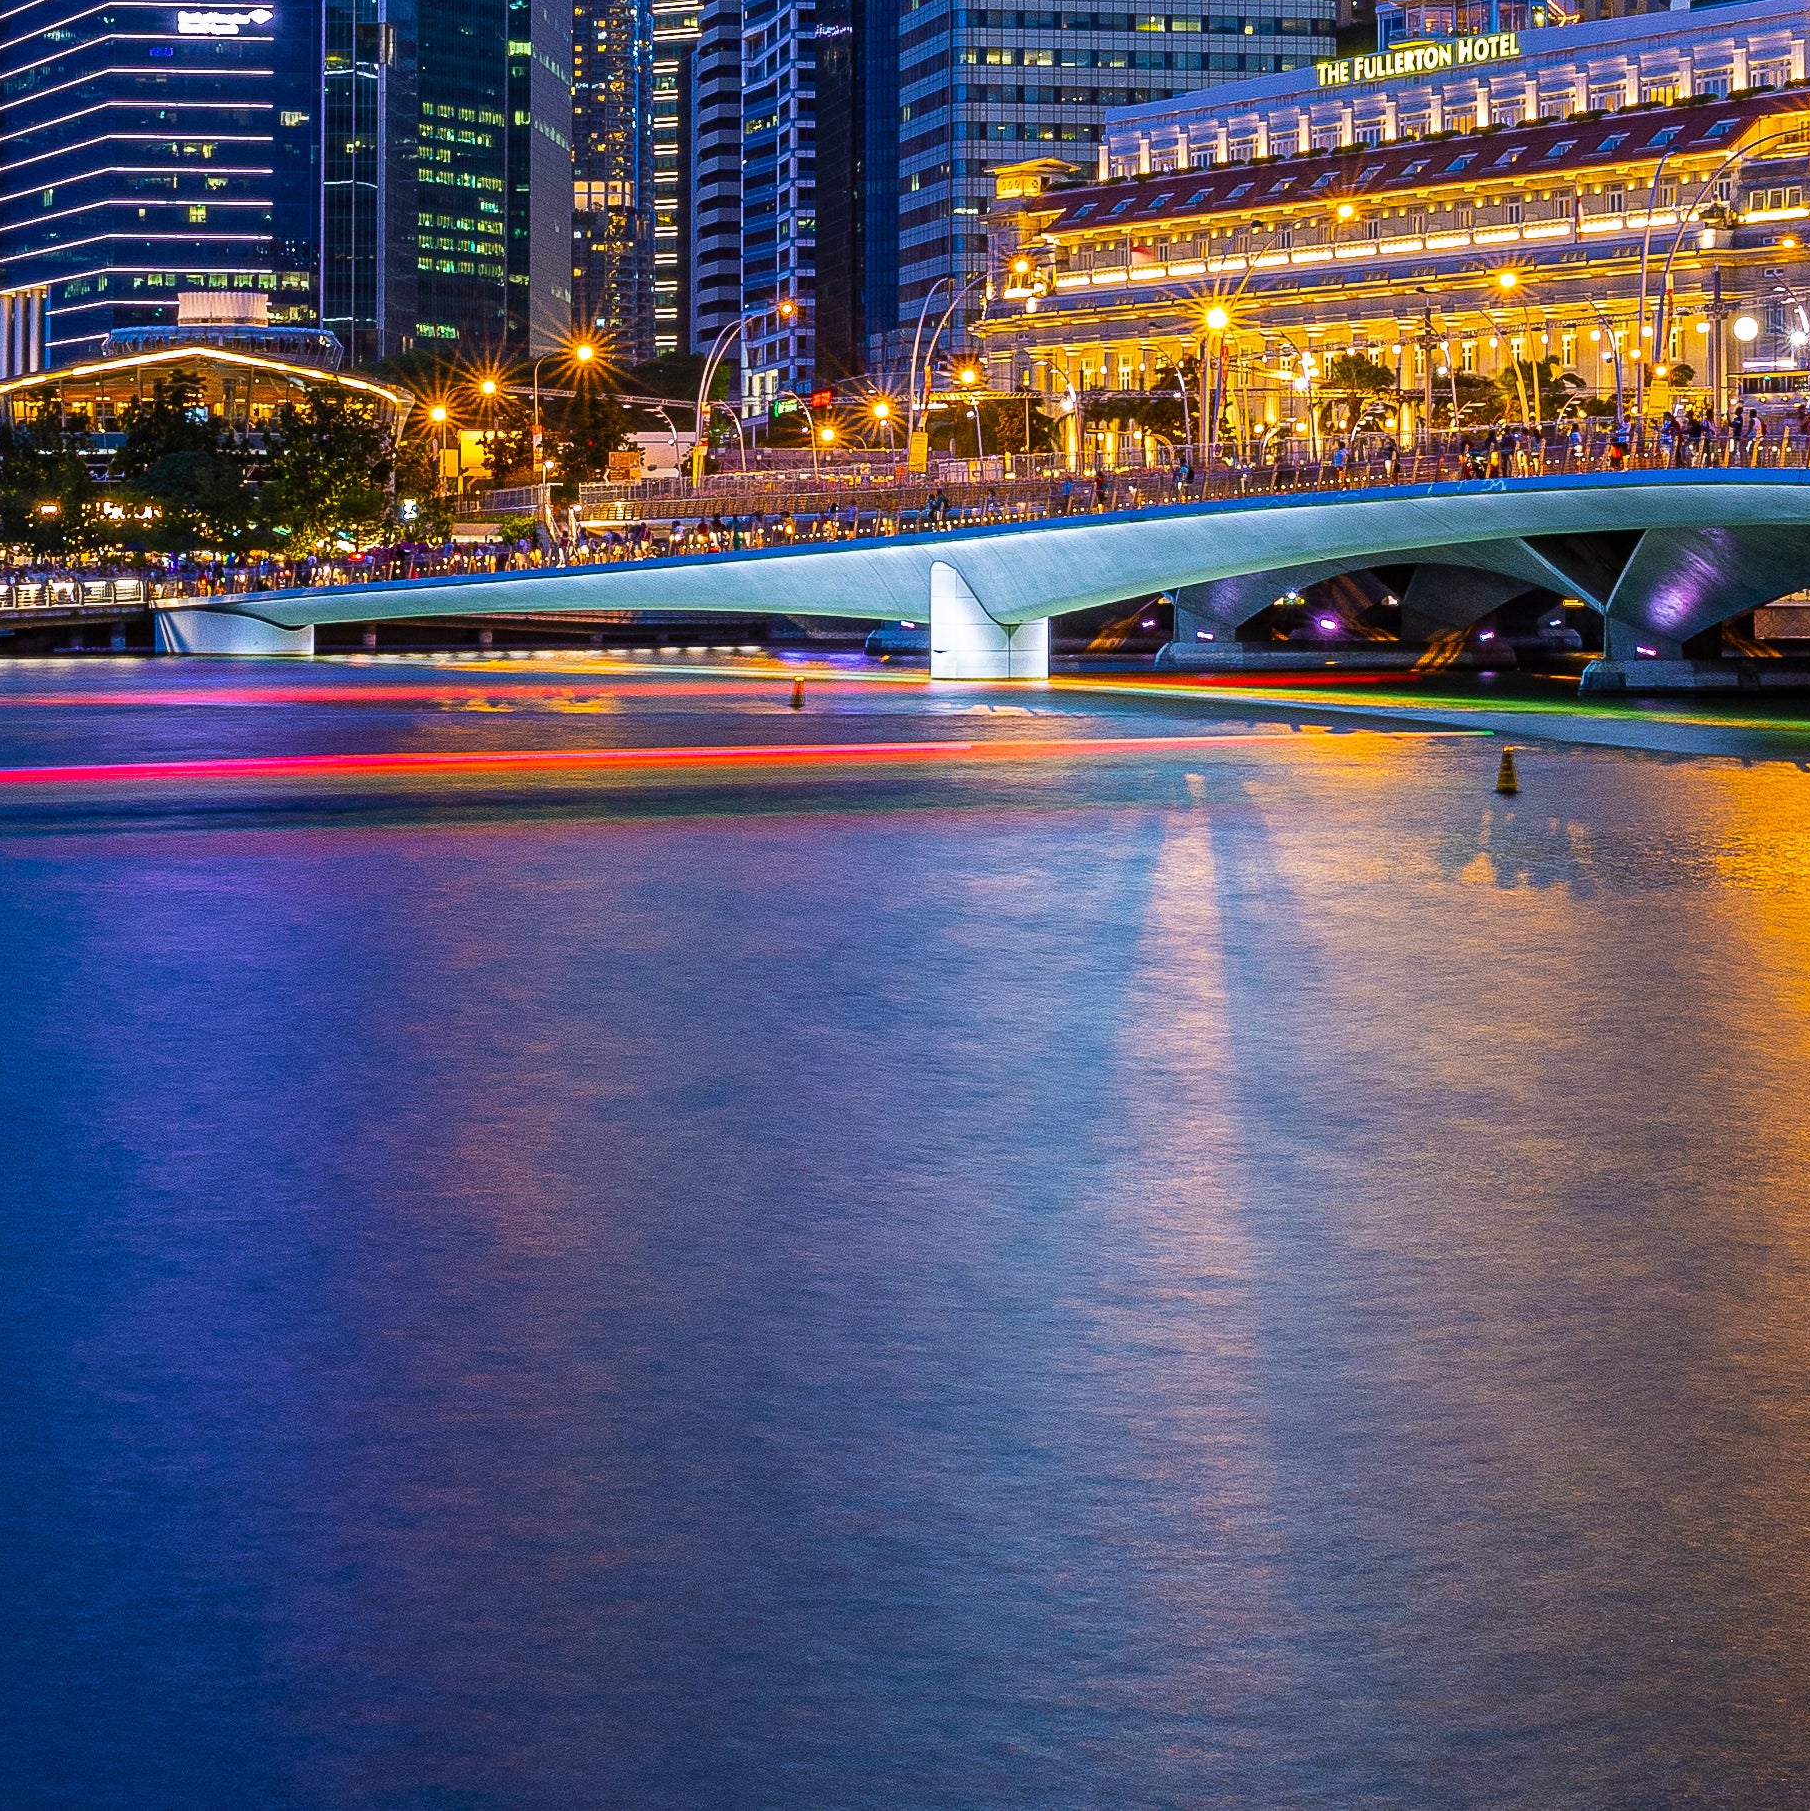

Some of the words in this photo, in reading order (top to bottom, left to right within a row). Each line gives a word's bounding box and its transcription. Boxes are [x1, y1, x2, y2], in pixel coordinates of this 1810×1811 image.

[1316, 61, 1351, 87] THE
[1352, 44, 1453, 81] FULLERTON
[1456, 32, 1520, 64] HOTEL
